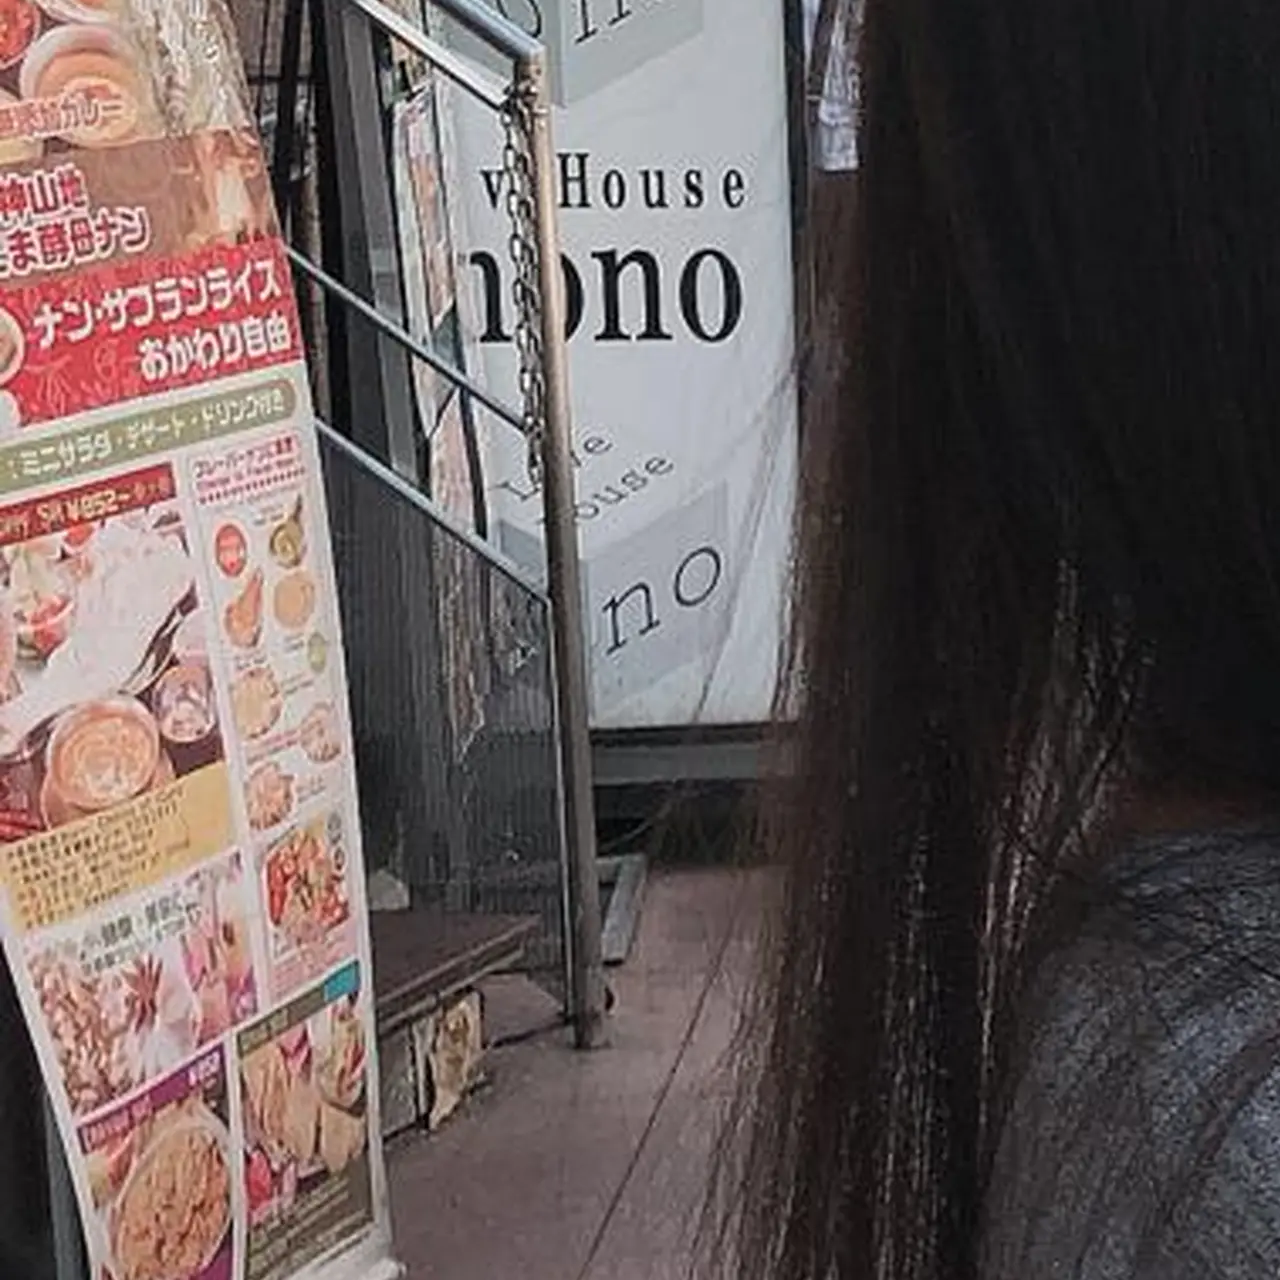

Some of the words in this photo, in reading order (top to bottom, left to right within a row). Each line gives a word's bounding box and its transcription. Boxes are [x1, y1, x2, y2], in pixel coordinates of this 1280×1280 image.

[557, 152, 747, 210] House
[0, 207, 150, 278] ま酵母ナン
[139, 313, 292, 383] おかわり自由
[603, 546, 722, 656] no
